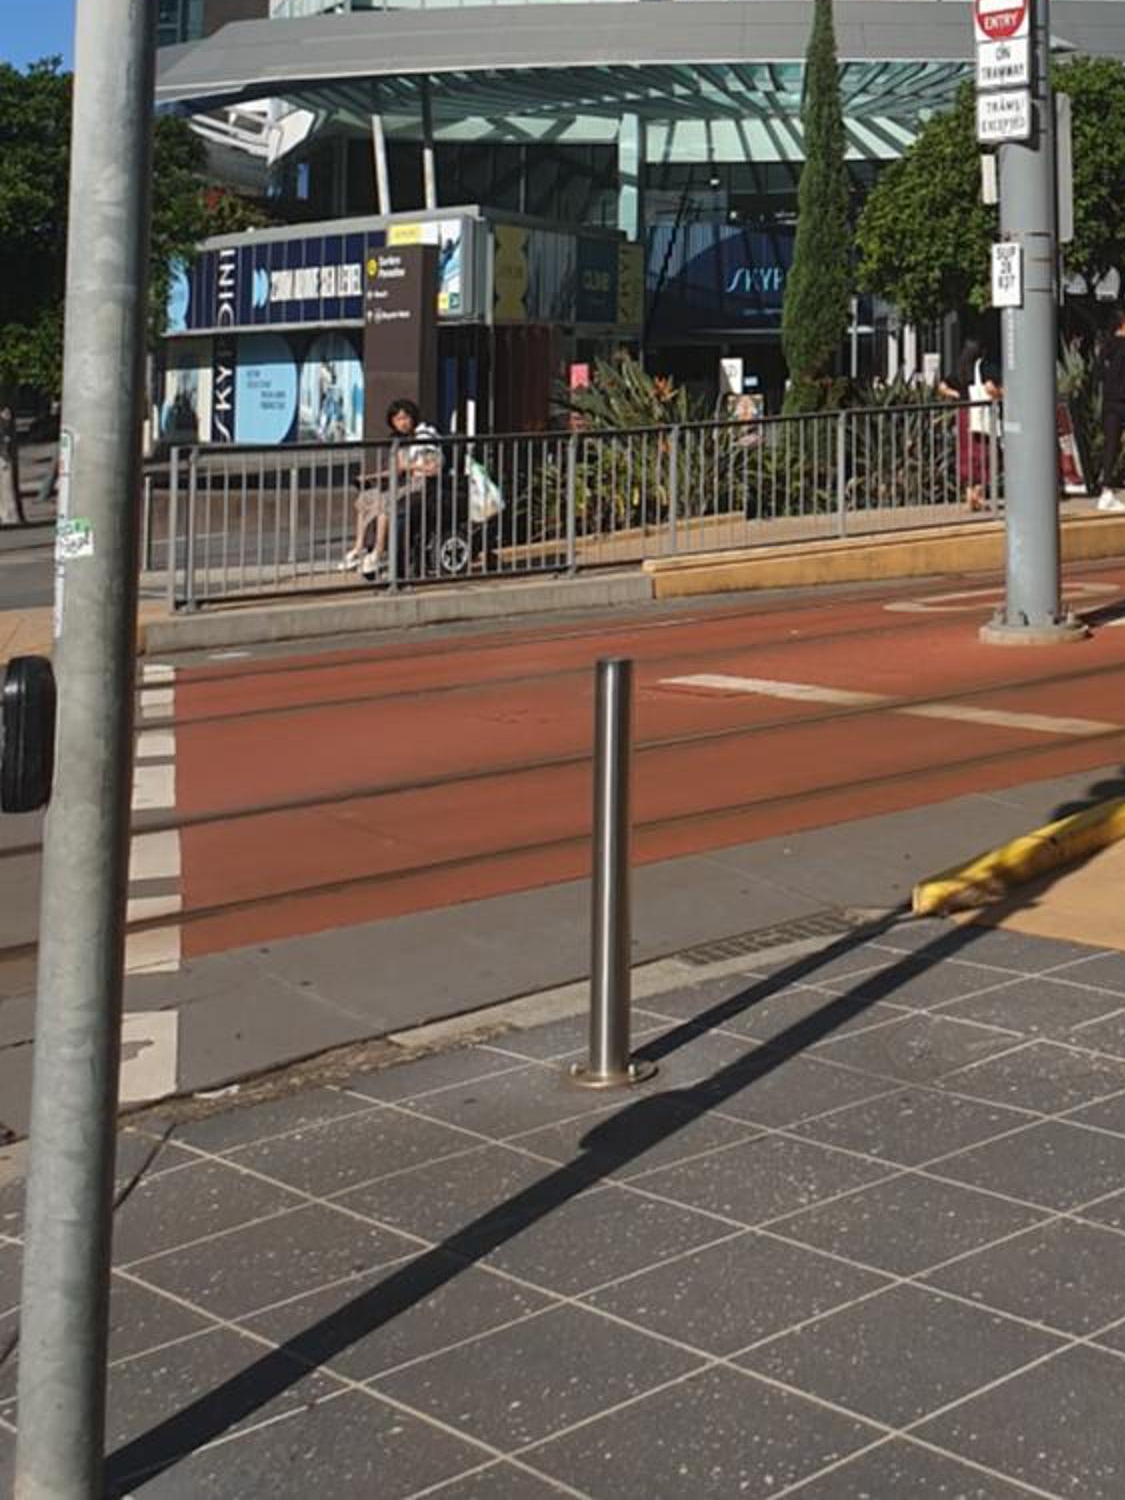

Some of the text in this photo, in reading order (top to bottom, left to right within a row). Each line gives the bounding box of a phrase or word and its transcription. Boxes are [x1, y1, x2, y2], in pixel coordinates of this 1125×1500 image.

[984, 12, 1018, 31] ENTRY
[995, 46, 1011, 61] ON
[982, 65, 1024, 80] TRAMWAY
